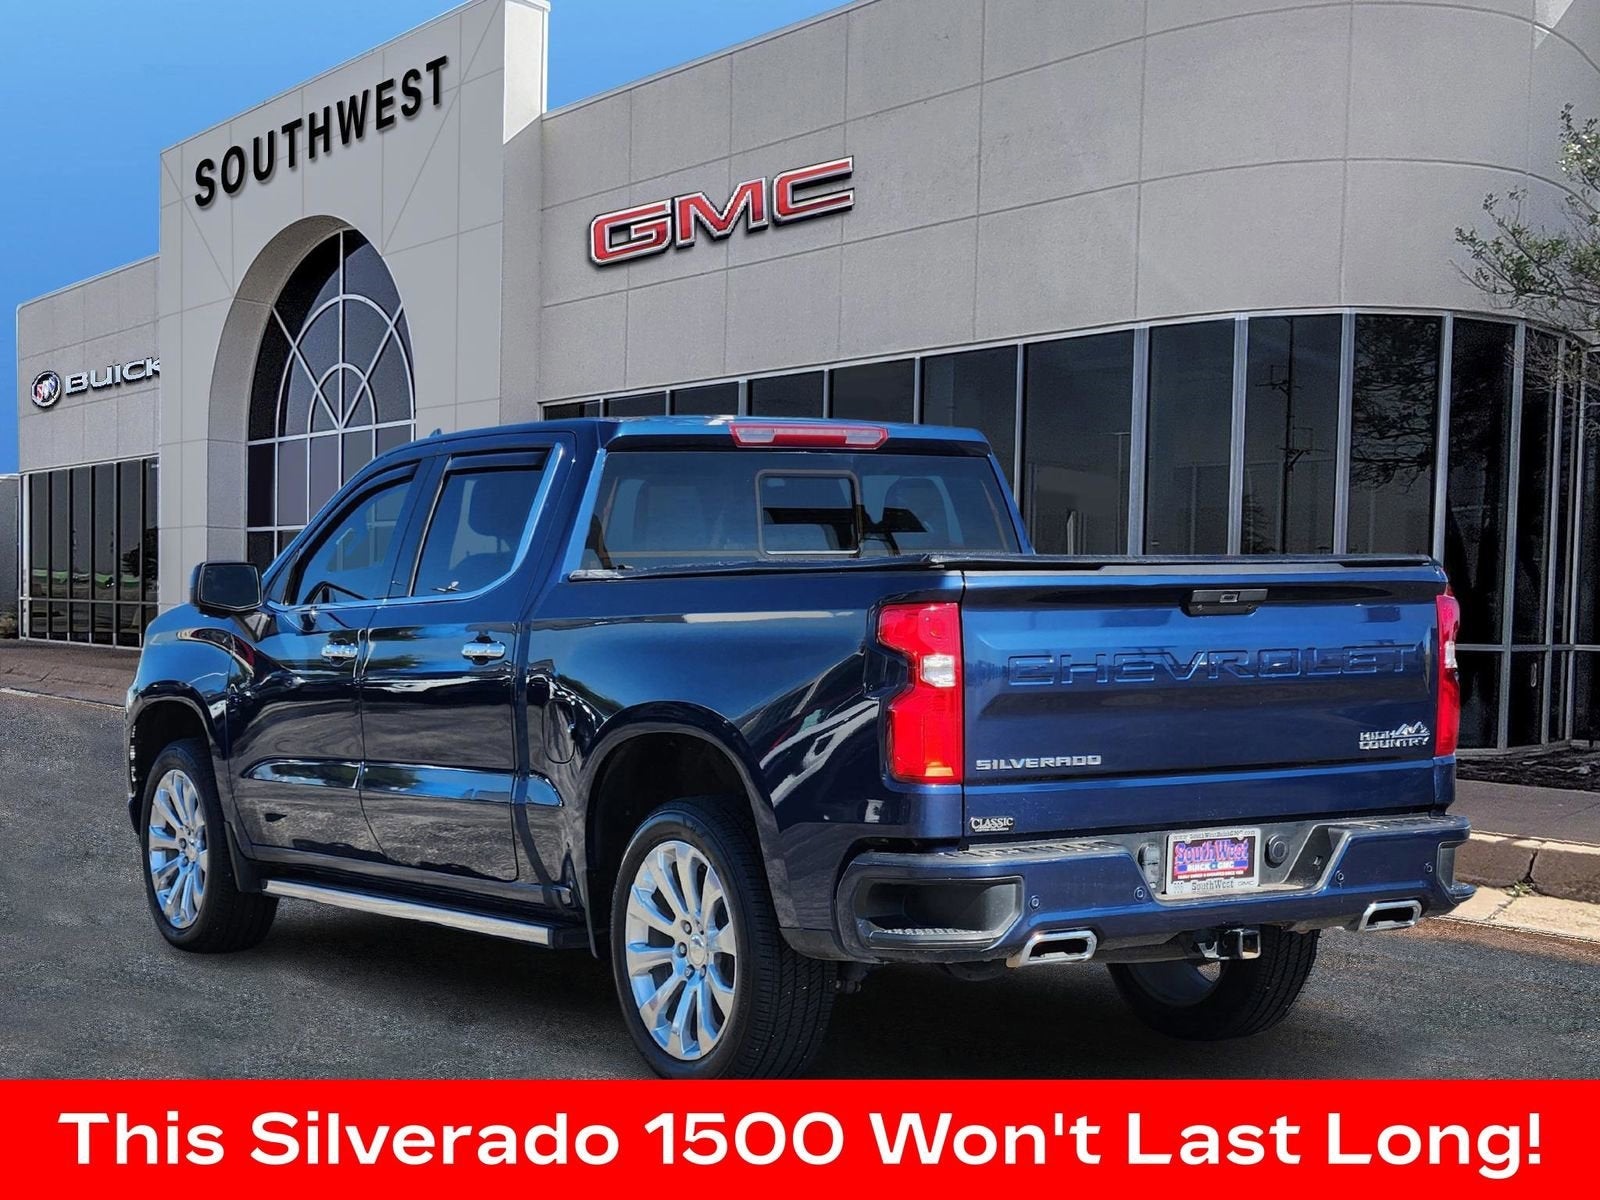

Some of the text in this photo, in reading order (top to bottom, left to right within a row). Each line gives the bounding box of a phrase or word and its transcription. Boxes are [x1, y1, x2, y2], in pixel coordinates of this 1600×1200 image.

[194, 55, 448, 208] SOUTHWEST
[589, 155, 855, 267] GMC
[1007, 644, 1418, 686] CHEVROLET
[1360, 730, 1396, 741] HIGH
[1359, 737, 1430, 750] COUNTRY
[975, 755, 1102, 770] SILVERADO
[971, 817, 1014, 829] CLASSIC
